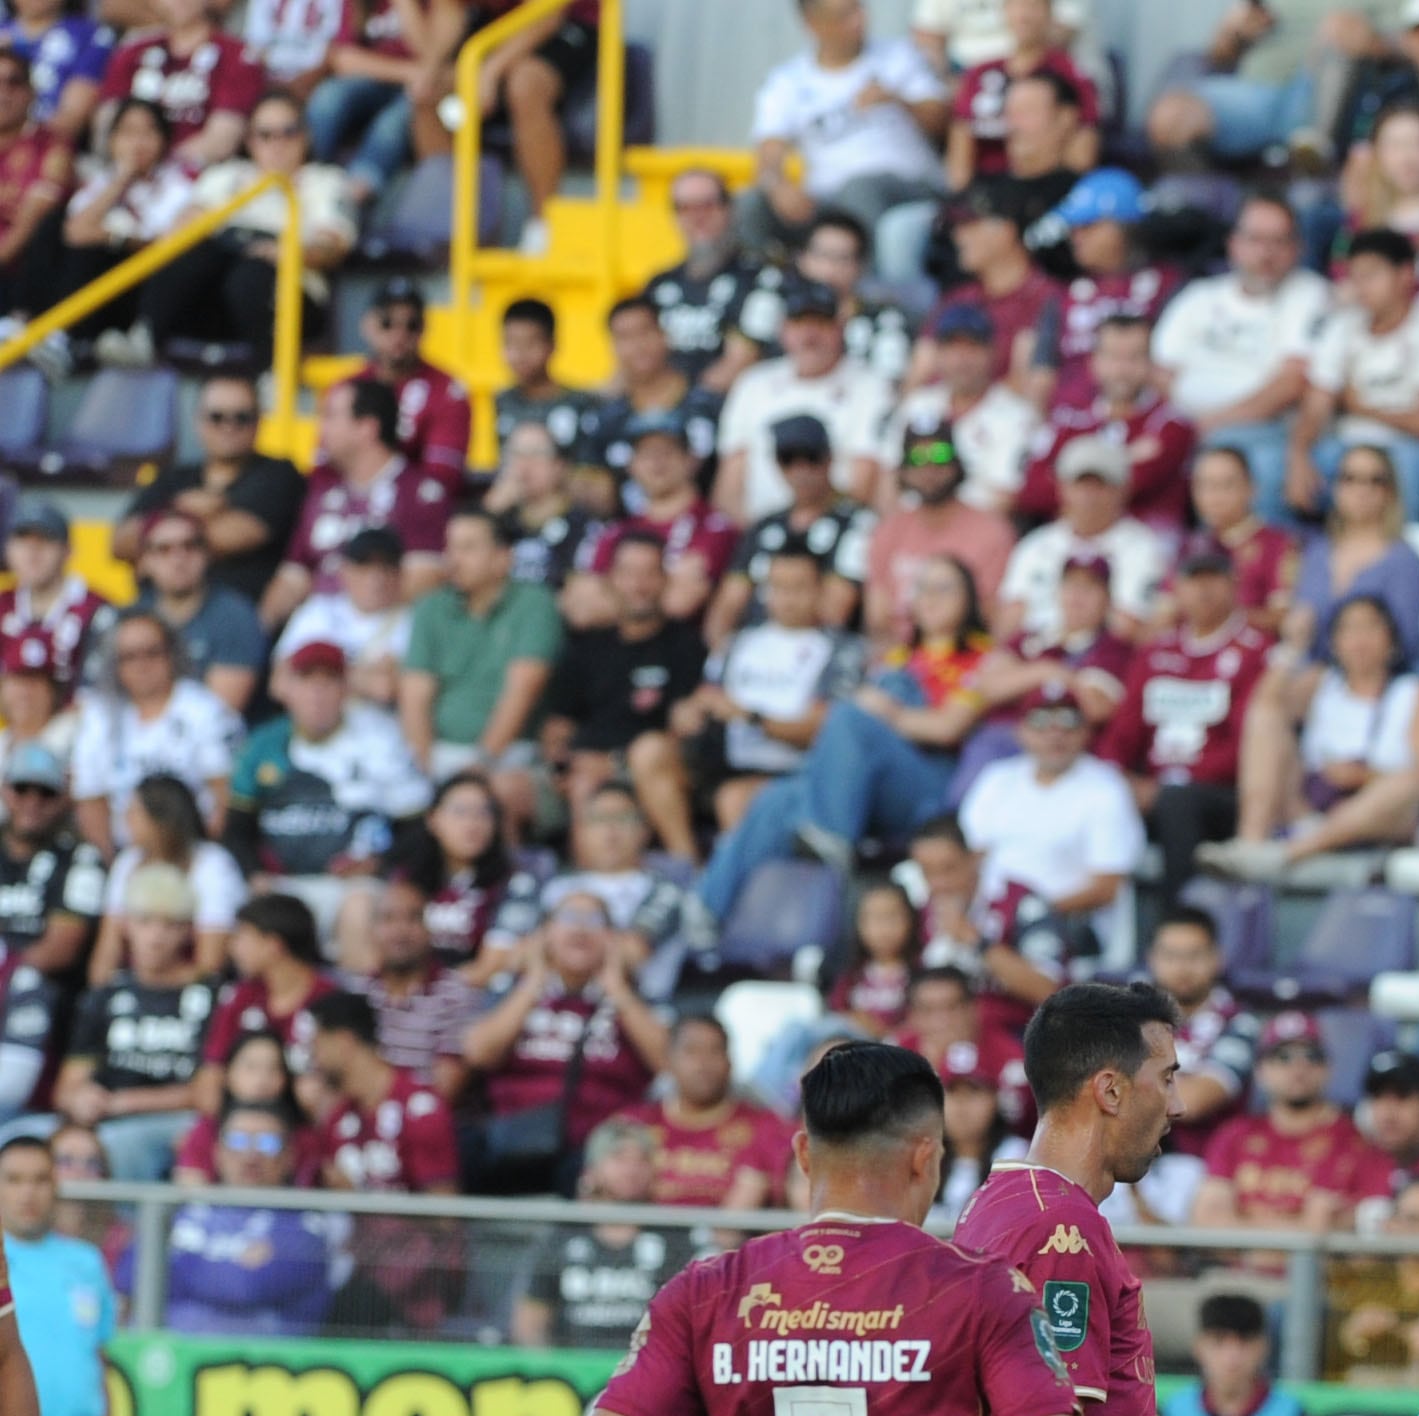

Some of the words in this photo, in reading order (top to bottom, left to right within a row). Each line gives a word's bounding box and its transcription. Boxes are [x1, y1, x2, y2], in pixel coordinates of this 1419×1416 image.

[760, 1301, 904, 1336] medismart
[713, 1343, 742, 1384] B.
[747, 1340, 931, 1381] HERNANDEZ
